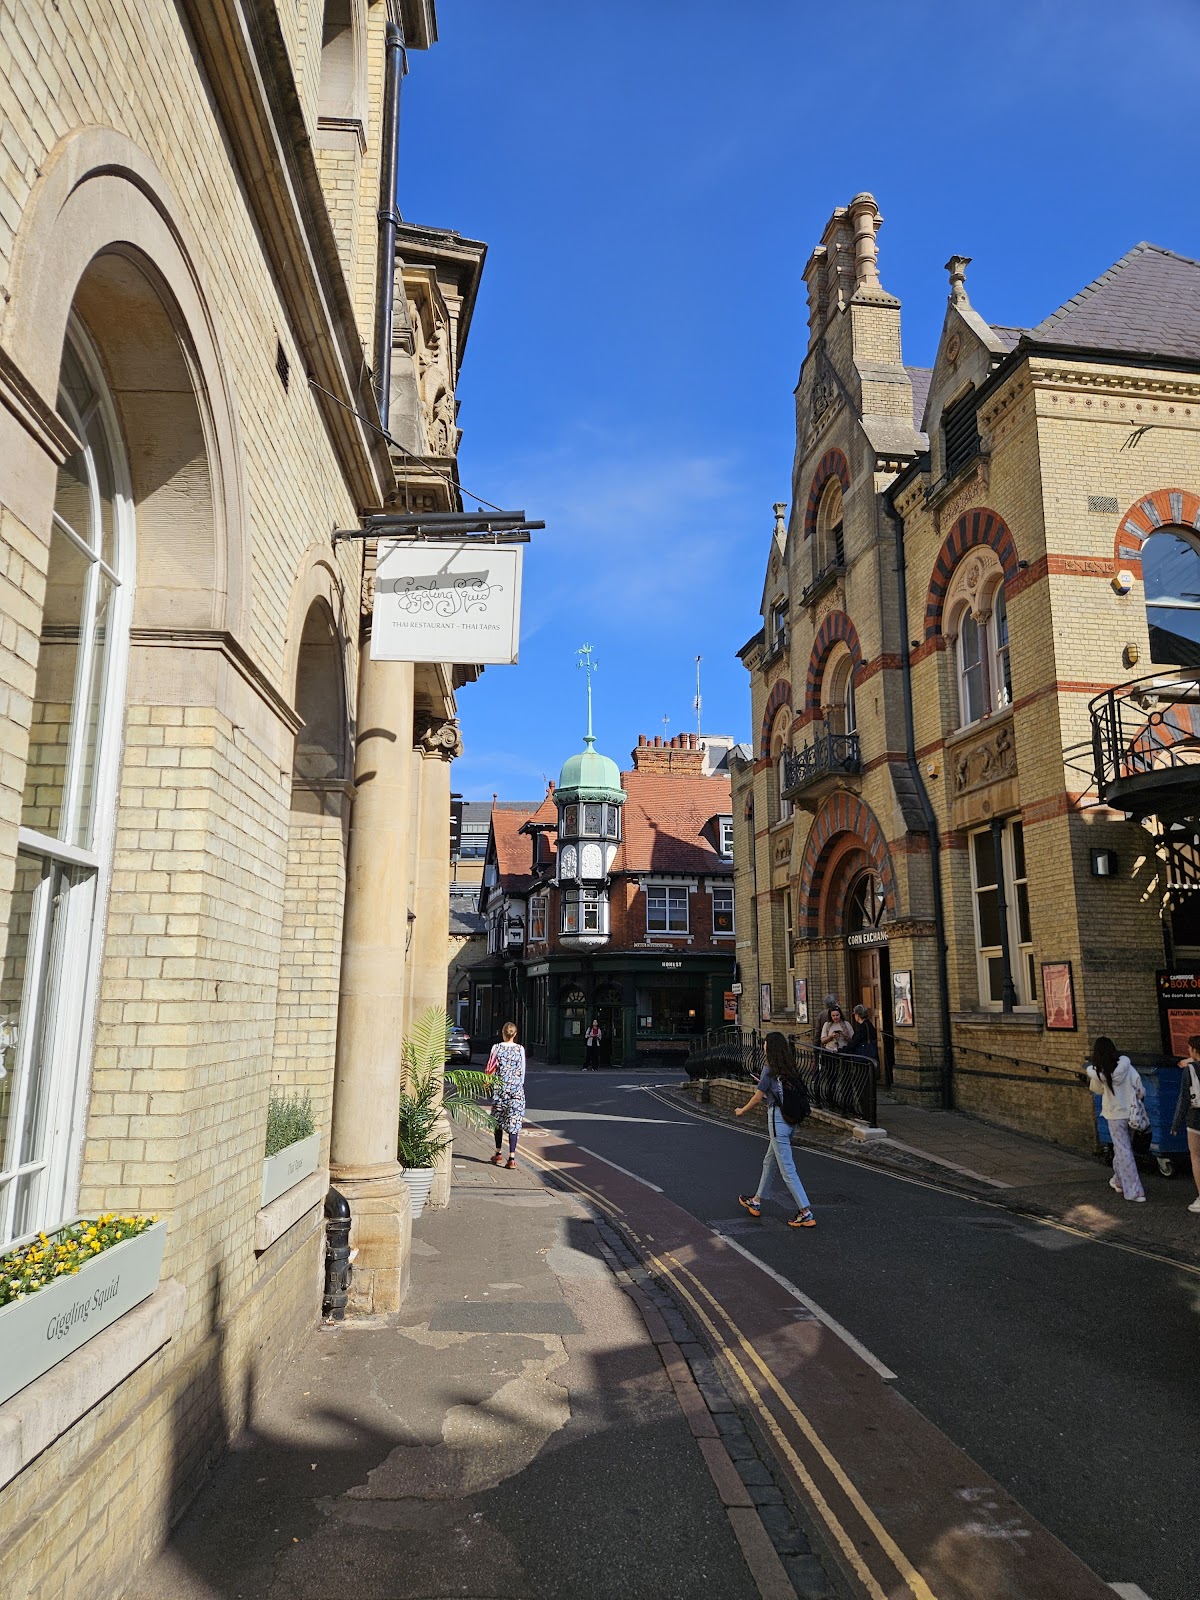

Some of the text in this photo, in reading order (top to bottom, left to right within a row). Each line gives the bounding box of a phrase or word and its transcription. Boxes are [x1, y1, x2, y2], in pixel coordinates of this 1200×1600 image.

[393, 576, 503, 617] Giggling Squid
[847, 931, 889, 946] CORN EXCHANG
[1170, 980, 1189, 988] BOX
[46, 1275, 121, 1341] Giggling Squid
